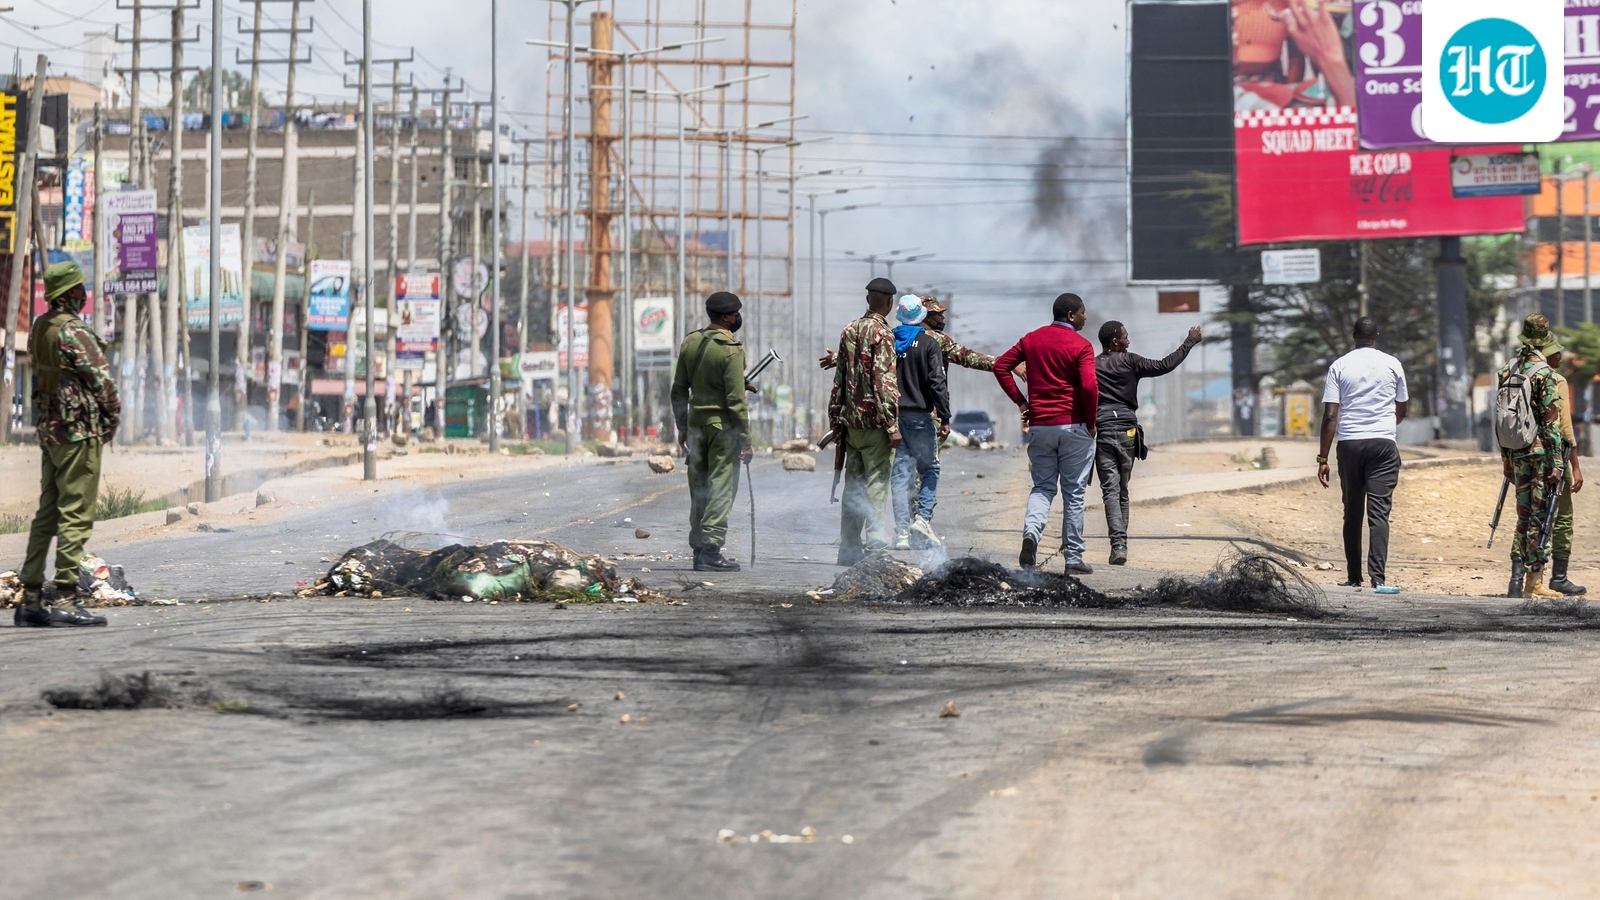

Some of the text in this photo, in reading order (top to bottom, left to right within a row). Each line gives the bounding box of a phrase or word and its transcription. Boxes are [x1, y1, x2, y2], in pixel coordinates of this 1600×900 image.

[1360, 0, 1406, 67] 3
[1365, 78, 1422, 95] One Sc
[1261, 129, 1313, 155] SQUAD
